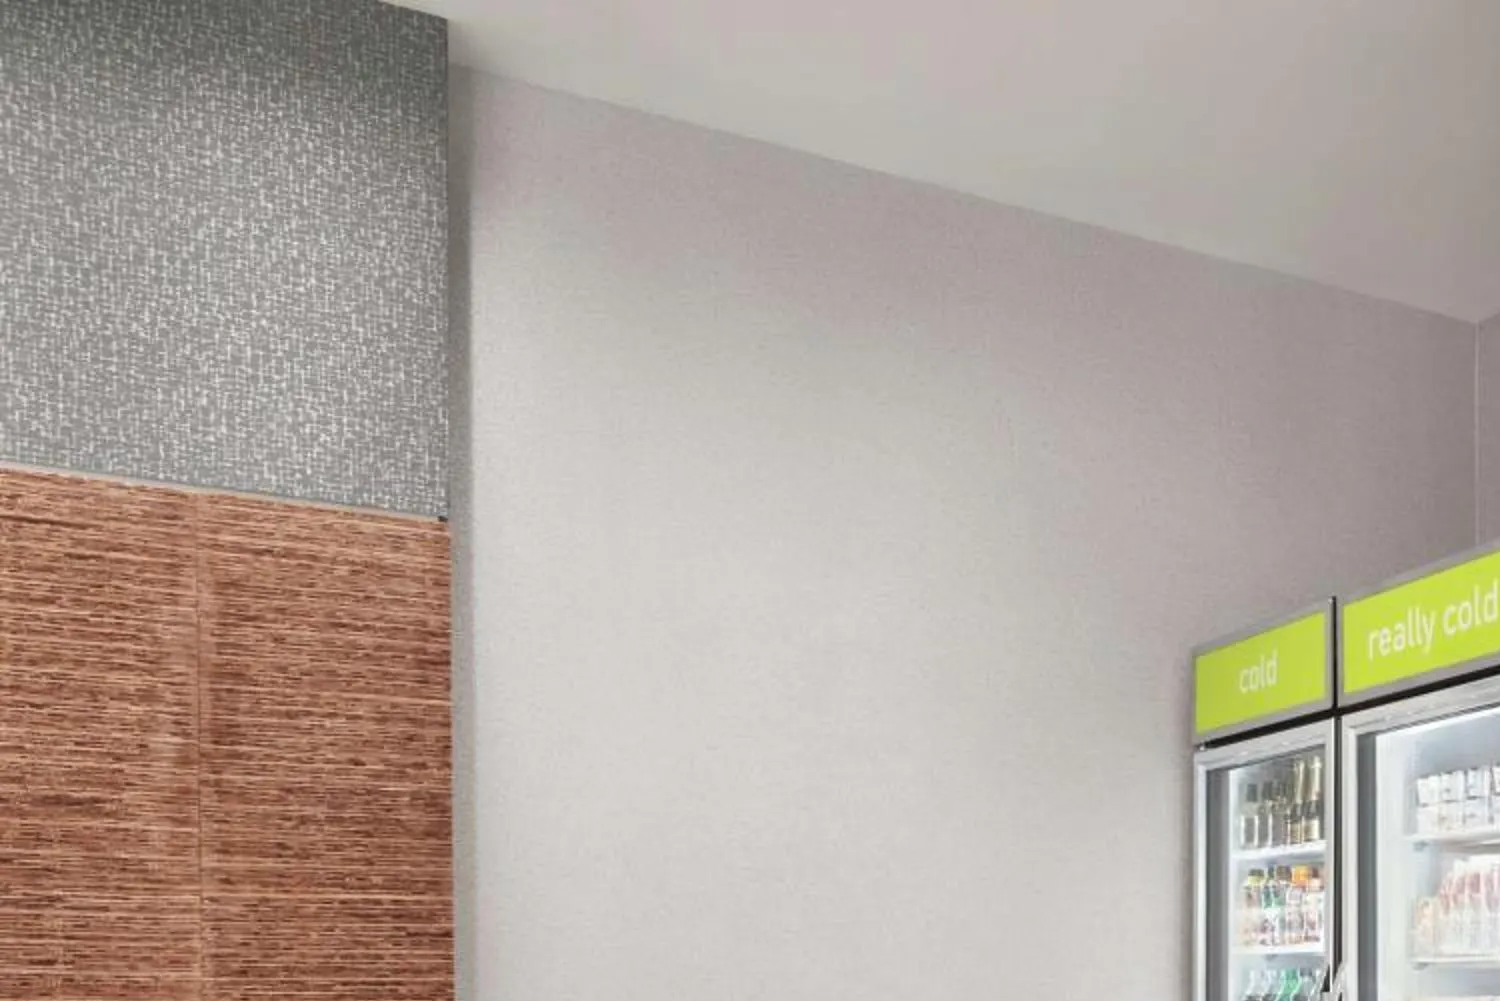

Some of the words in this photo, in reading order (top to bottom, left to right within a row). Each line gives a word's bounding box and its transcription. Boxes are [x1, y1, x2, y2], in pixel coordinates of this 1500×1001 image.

[1367, 605, 1438, 662] really
[1442, 577, 1500, 636] cold
[1238, 649, 1279, 694] cold
